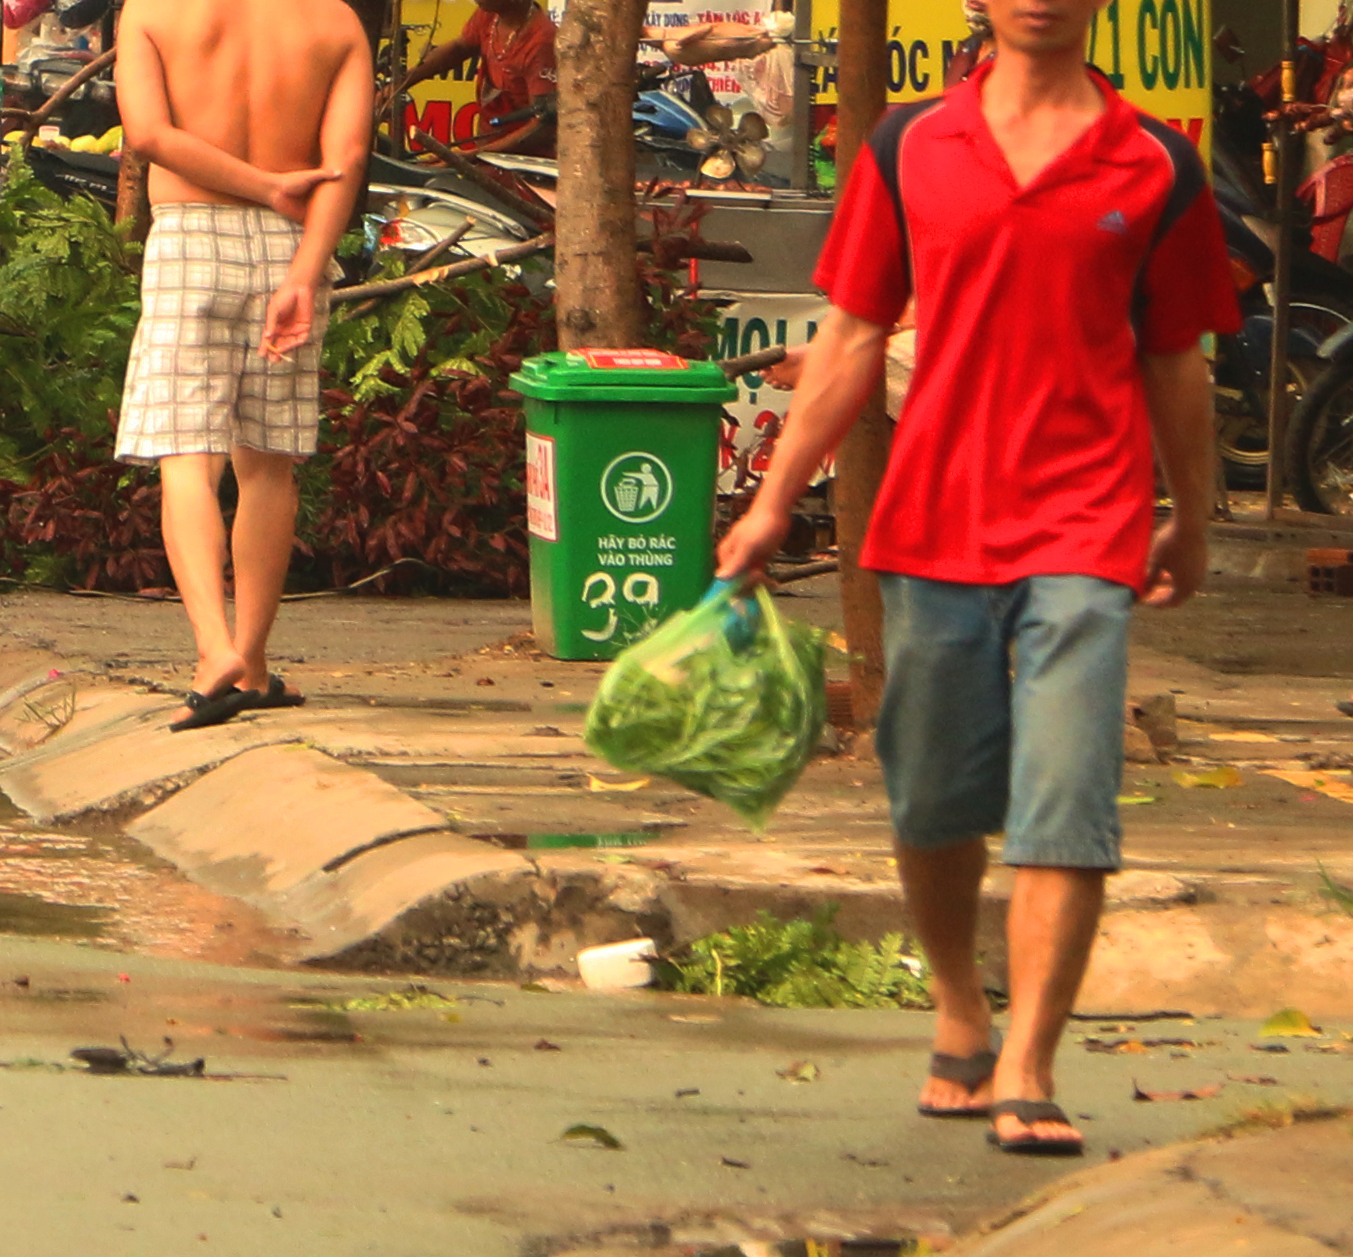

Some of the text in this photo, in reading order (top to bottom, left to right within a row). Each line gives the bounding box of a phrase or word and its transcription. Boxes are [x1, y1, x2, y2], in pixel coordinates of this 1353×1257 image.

[597, 533, 676, 550] HÃY BỎ RÁC
[597, 549, 674, 566] VÀO THÙNG
